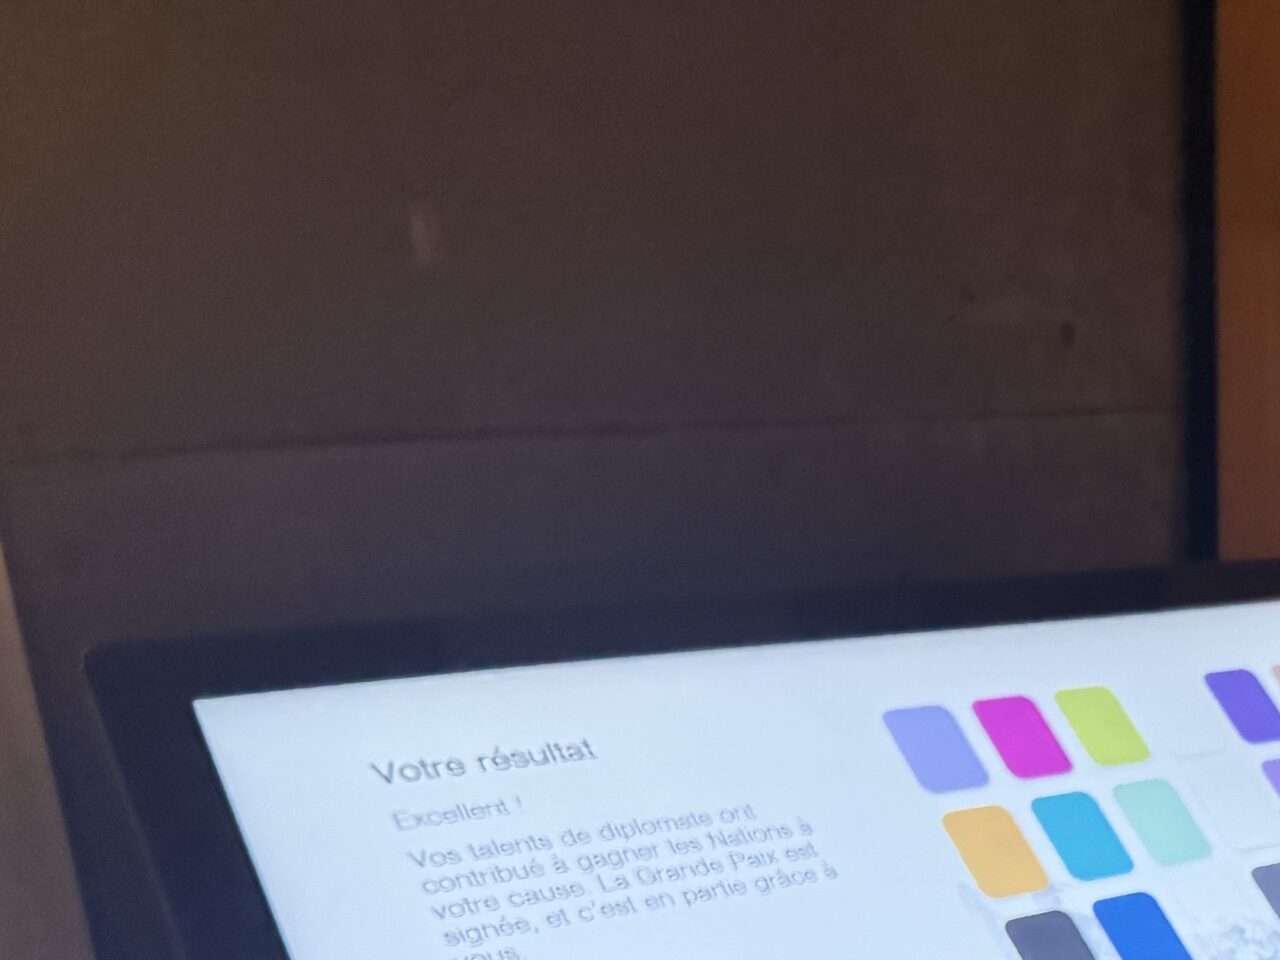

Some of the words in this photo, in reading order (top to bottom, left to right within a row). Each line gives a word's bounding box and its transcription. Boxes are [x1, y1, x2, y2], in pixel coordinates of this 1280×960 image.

[370, 756, 466, 784] Votre
[477, 738, 597, 771] résultat
[392, 799, 511, 831] Excellent
[408, 849, 462, 868] Vos
[467, 834, 553, 861] talents
[560, 828, 592, 847] de
[599, 810, 714, 843] diplomate
[719, 803, 757, 824] ont
[422, 858, 545, 895] contribué
[552, 853, 570, 874] à
[577, 844, 660, 875] gagner
[667, 836, 703, 855] les
[706, 820, 794, 850] Nations
[796, 815, 814, 837] à
[430, 895, 500, 920] votre
[597, 873, 630, 894] La
[635, 857, 724, 886] Grande
[728, 849, 780, 871] Paix
[784, 841, 819, 862] est
[443, 915, 539, 948] signée,
[546, 908, 572, 928] et
[644, 891, 676, 912] en
[683, 878, 748, 908] partie
[754, 867, 818, 896] grâce
[822, 859, 838, 880] à
